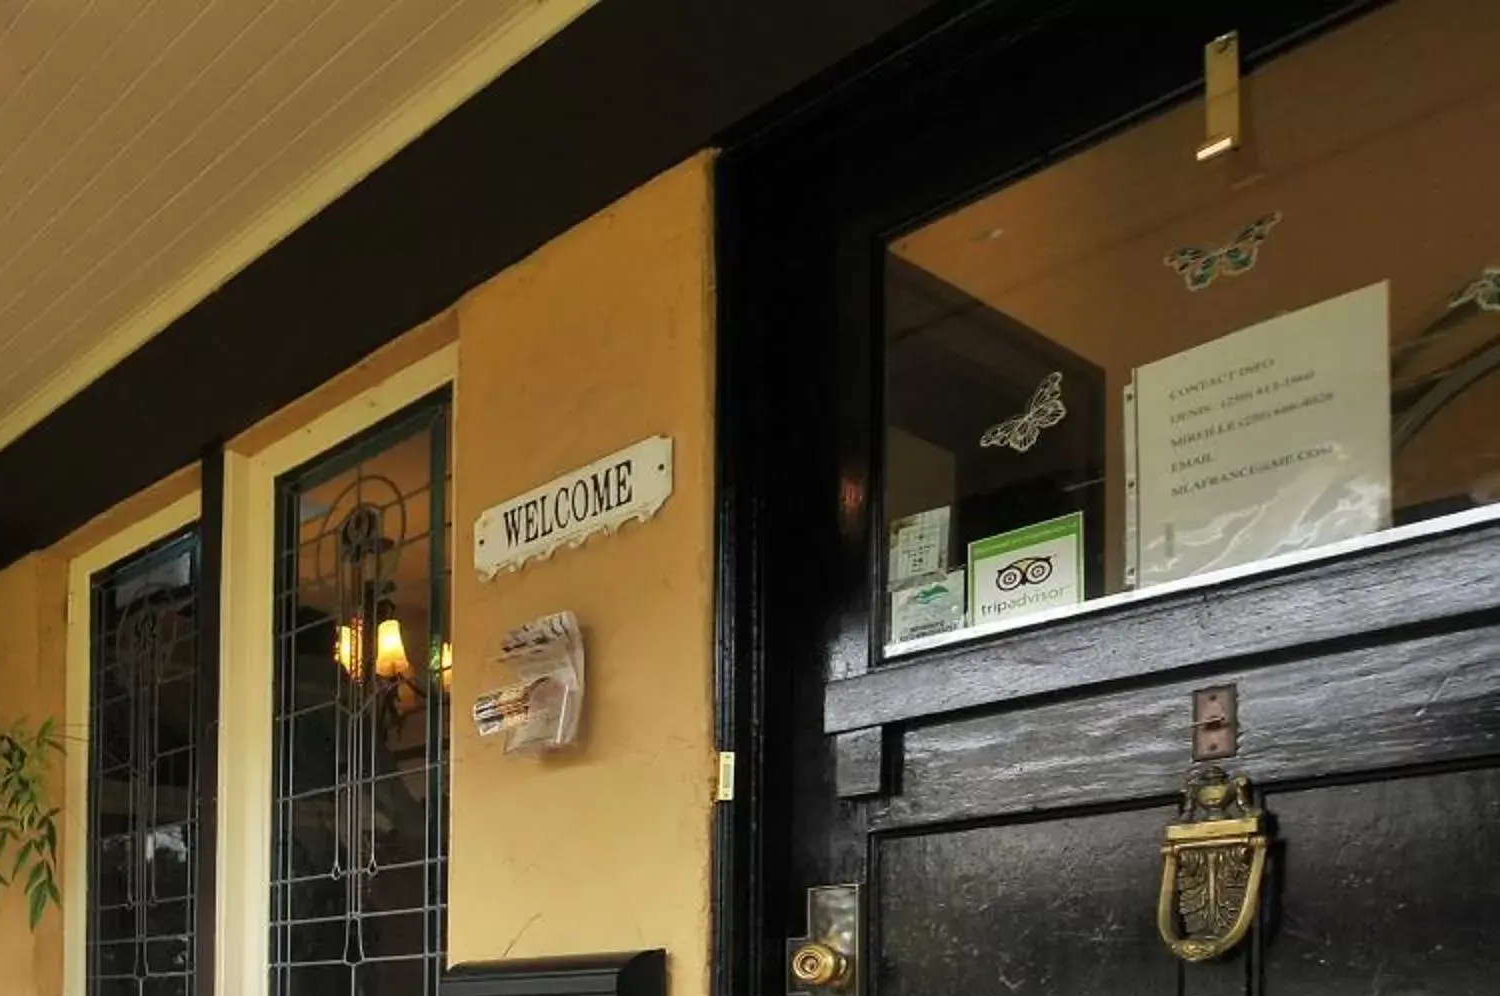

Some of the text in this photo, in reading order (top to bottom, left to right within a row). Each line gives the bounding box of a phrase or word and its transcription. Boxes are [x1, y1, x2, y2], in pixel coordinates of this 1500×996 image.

[1169, 358, 1274, 401] CONTACT INFO
[503, 459, 633, 551] WELCOME
[981, 586, 1065, 616] tripadvisor
